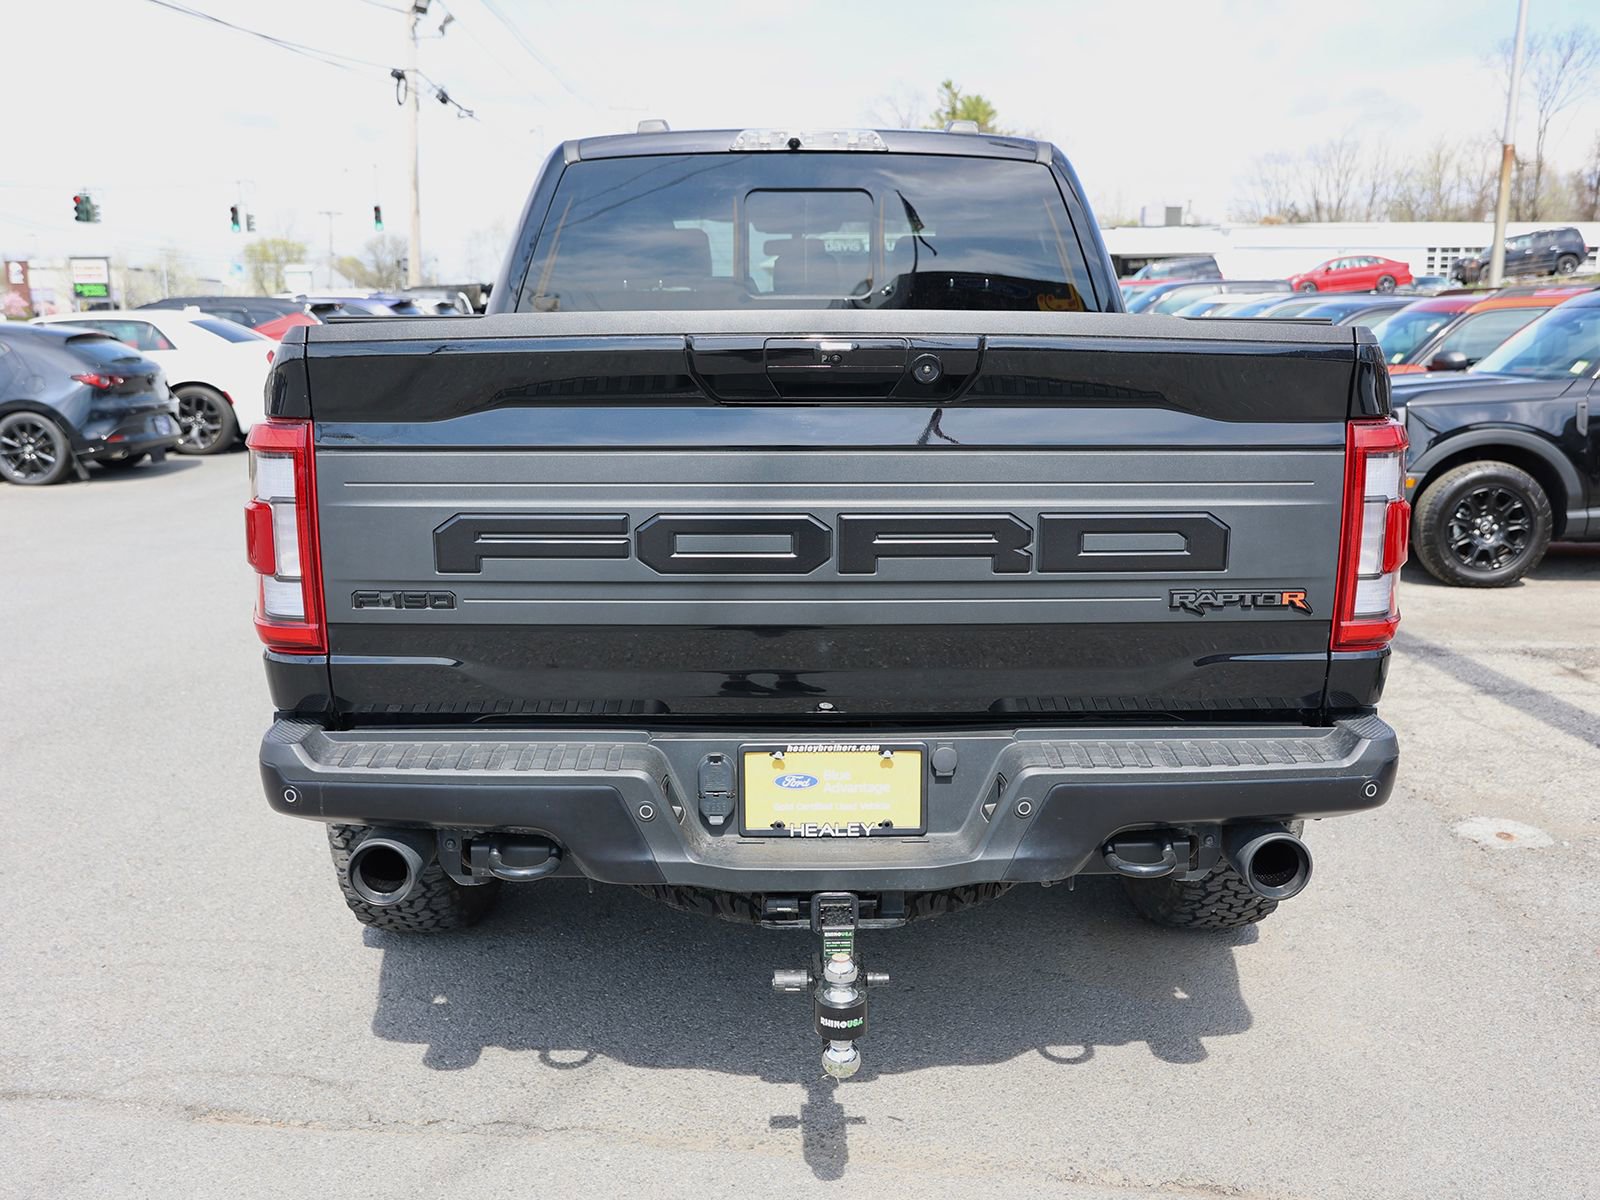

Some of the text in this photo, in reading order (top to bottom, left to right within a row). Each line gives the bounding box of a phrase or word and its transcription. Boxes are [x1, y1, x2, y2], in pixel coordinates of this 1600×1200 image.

[433, 512, 1231, 576] FORD
[351, 590, 457, 610] F-150
[1168, 588, 1313, 616] RAPTOR
[786, 744, 880, 753] healeybrothers.com
[789, 822, 876, 838] HEALEY
